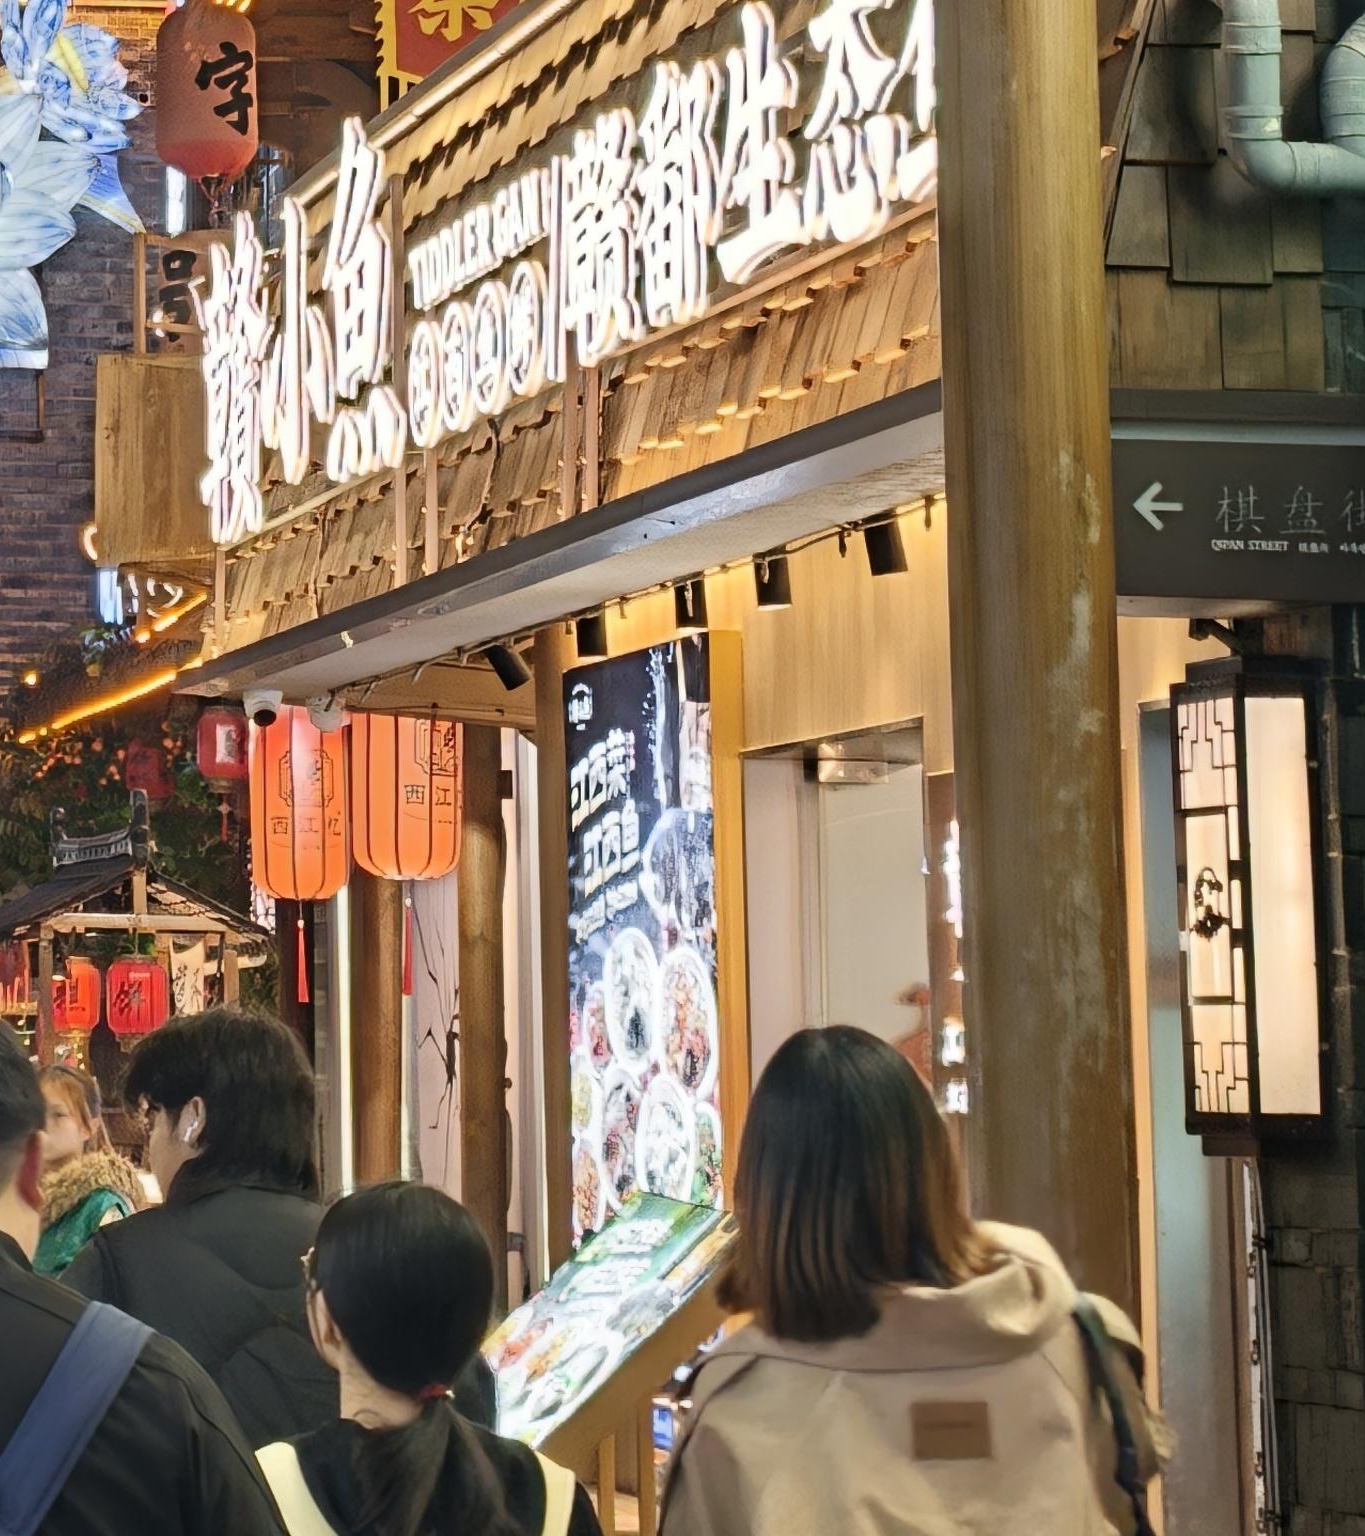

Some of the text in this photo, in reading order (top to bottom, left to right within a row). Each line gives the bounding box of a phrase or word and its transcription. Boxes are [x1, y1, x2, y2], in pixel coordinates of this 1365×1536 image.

[195, 42, 253, 135] 字
[408, 203, 503, 312] TIDDLER
[1247, 540, 1289, 552] STREET
